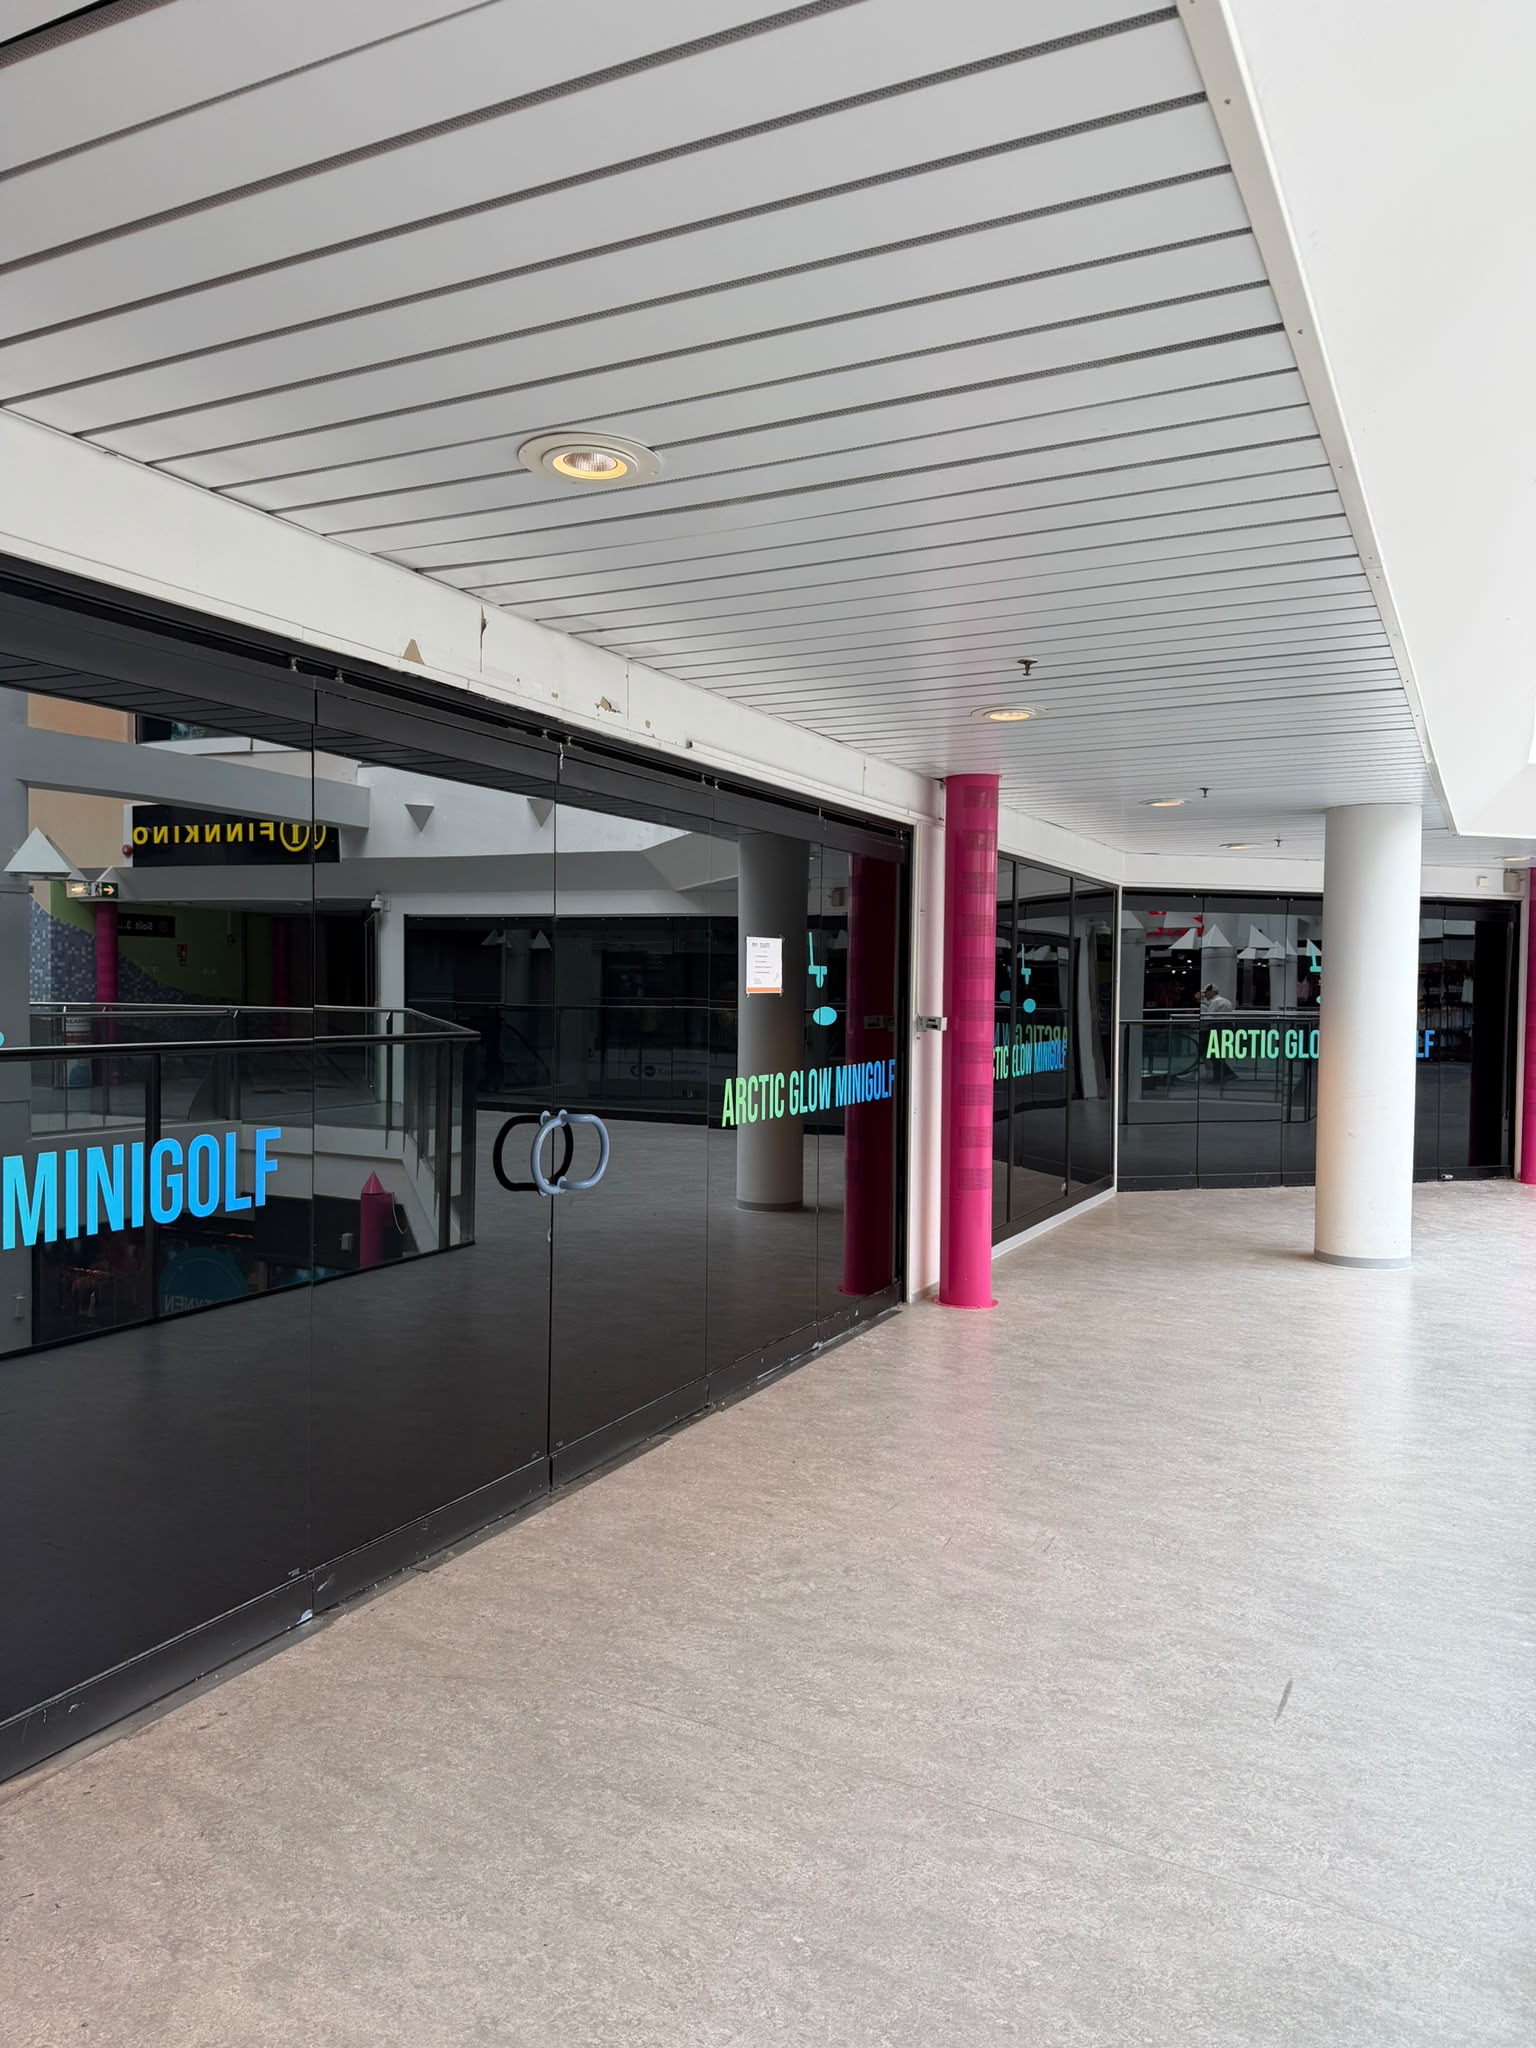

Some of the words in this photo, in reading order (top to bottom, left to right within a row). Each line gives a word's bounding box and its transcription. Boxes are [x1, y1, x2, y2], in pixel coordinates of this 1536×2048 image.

[993, 1045, 1009, 1080] TIC
[1034, 1039, 1067, 1074] MINIGOLF
[1206, 1029, 1280, 1059] ARCTIC
[1285, 1029, 1320, 1059] GLO
[722, 1072, 785, 1127] ARCTIC
[789, 1067, 832, 1116] GLOW
[835, 1059, 896, 1107] MINIGOLF
[2, 1127, 282, 1250] MINIGOLF
